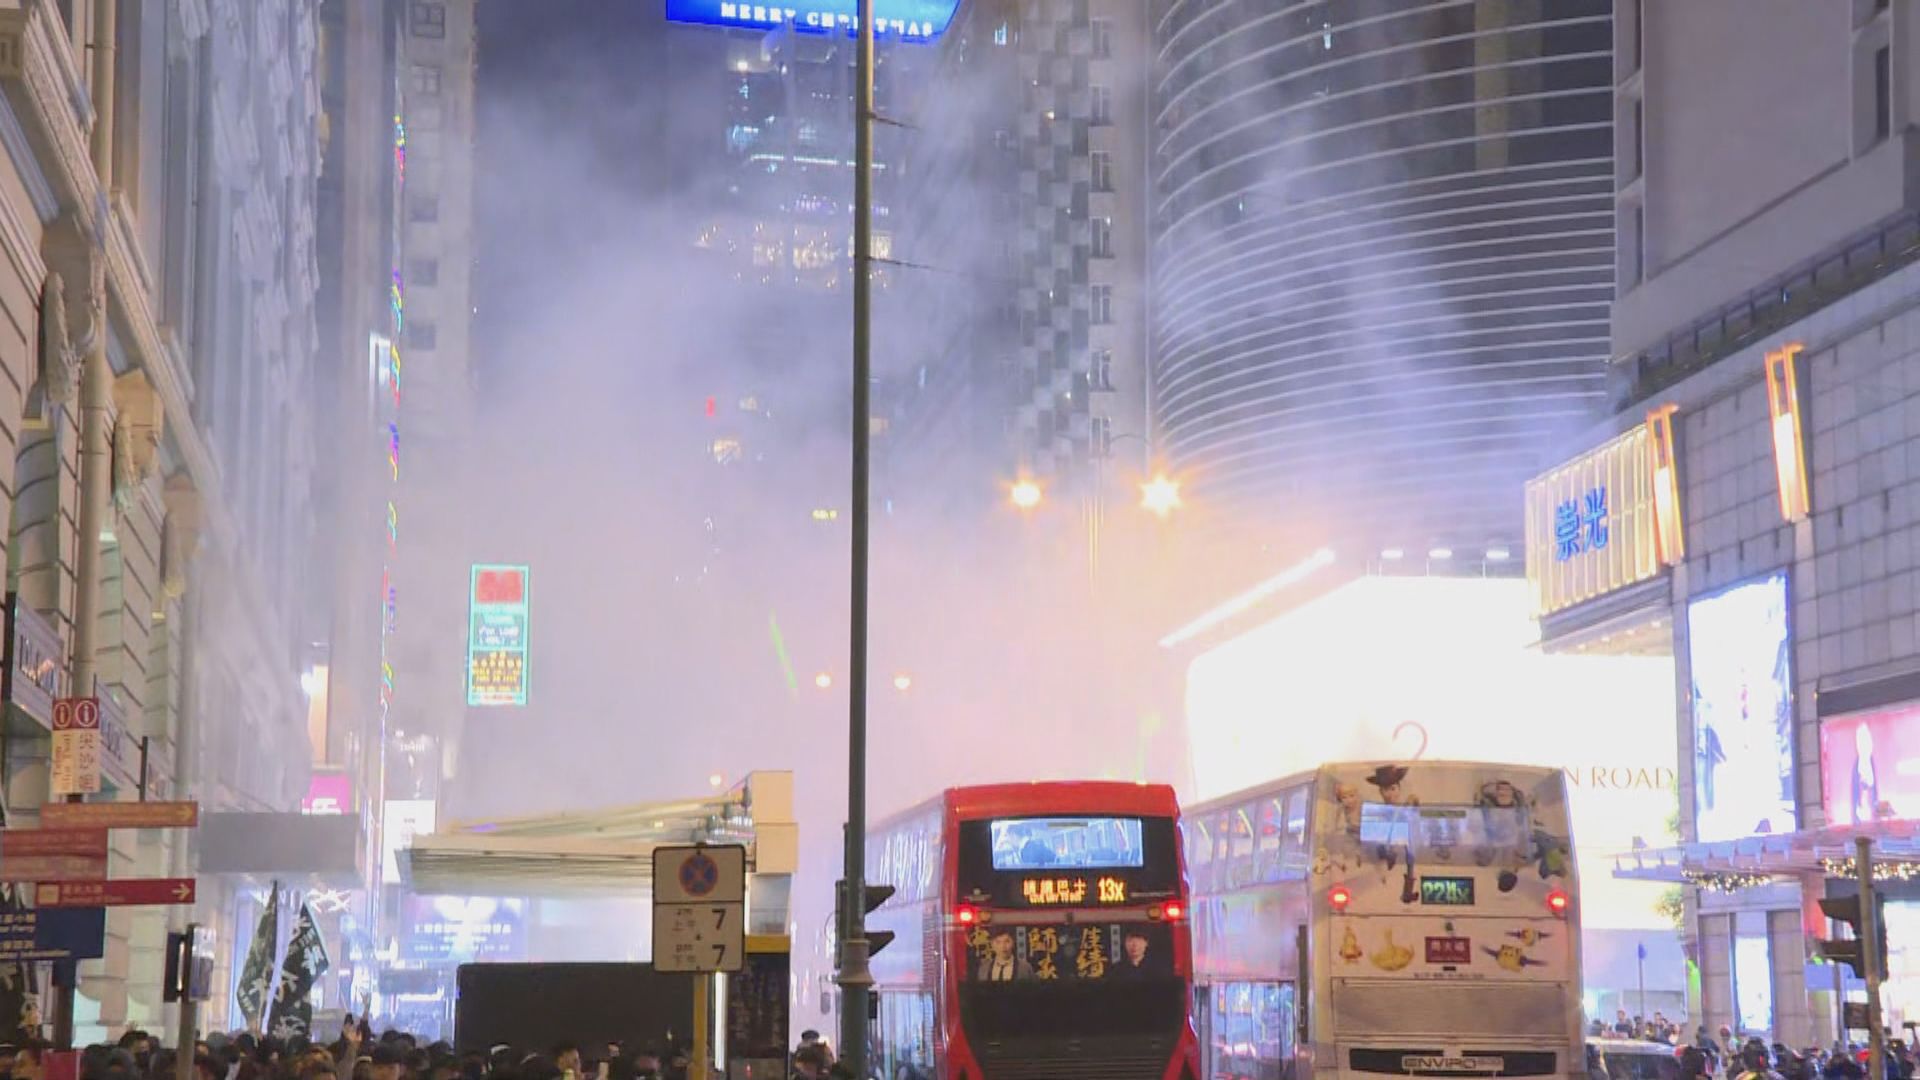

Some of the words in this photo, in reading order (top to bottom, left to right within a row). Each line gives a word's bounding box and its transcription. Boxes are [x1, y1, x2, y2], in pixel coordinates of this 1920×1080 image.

[721, 3, 796, 24] MERRY
[1555, 484, 1608, 561] 崇光
[1591, 766, 1675, 789] ROAD
[712, 908, 726, 930] 7
[712, 944, 726, 966] 7
